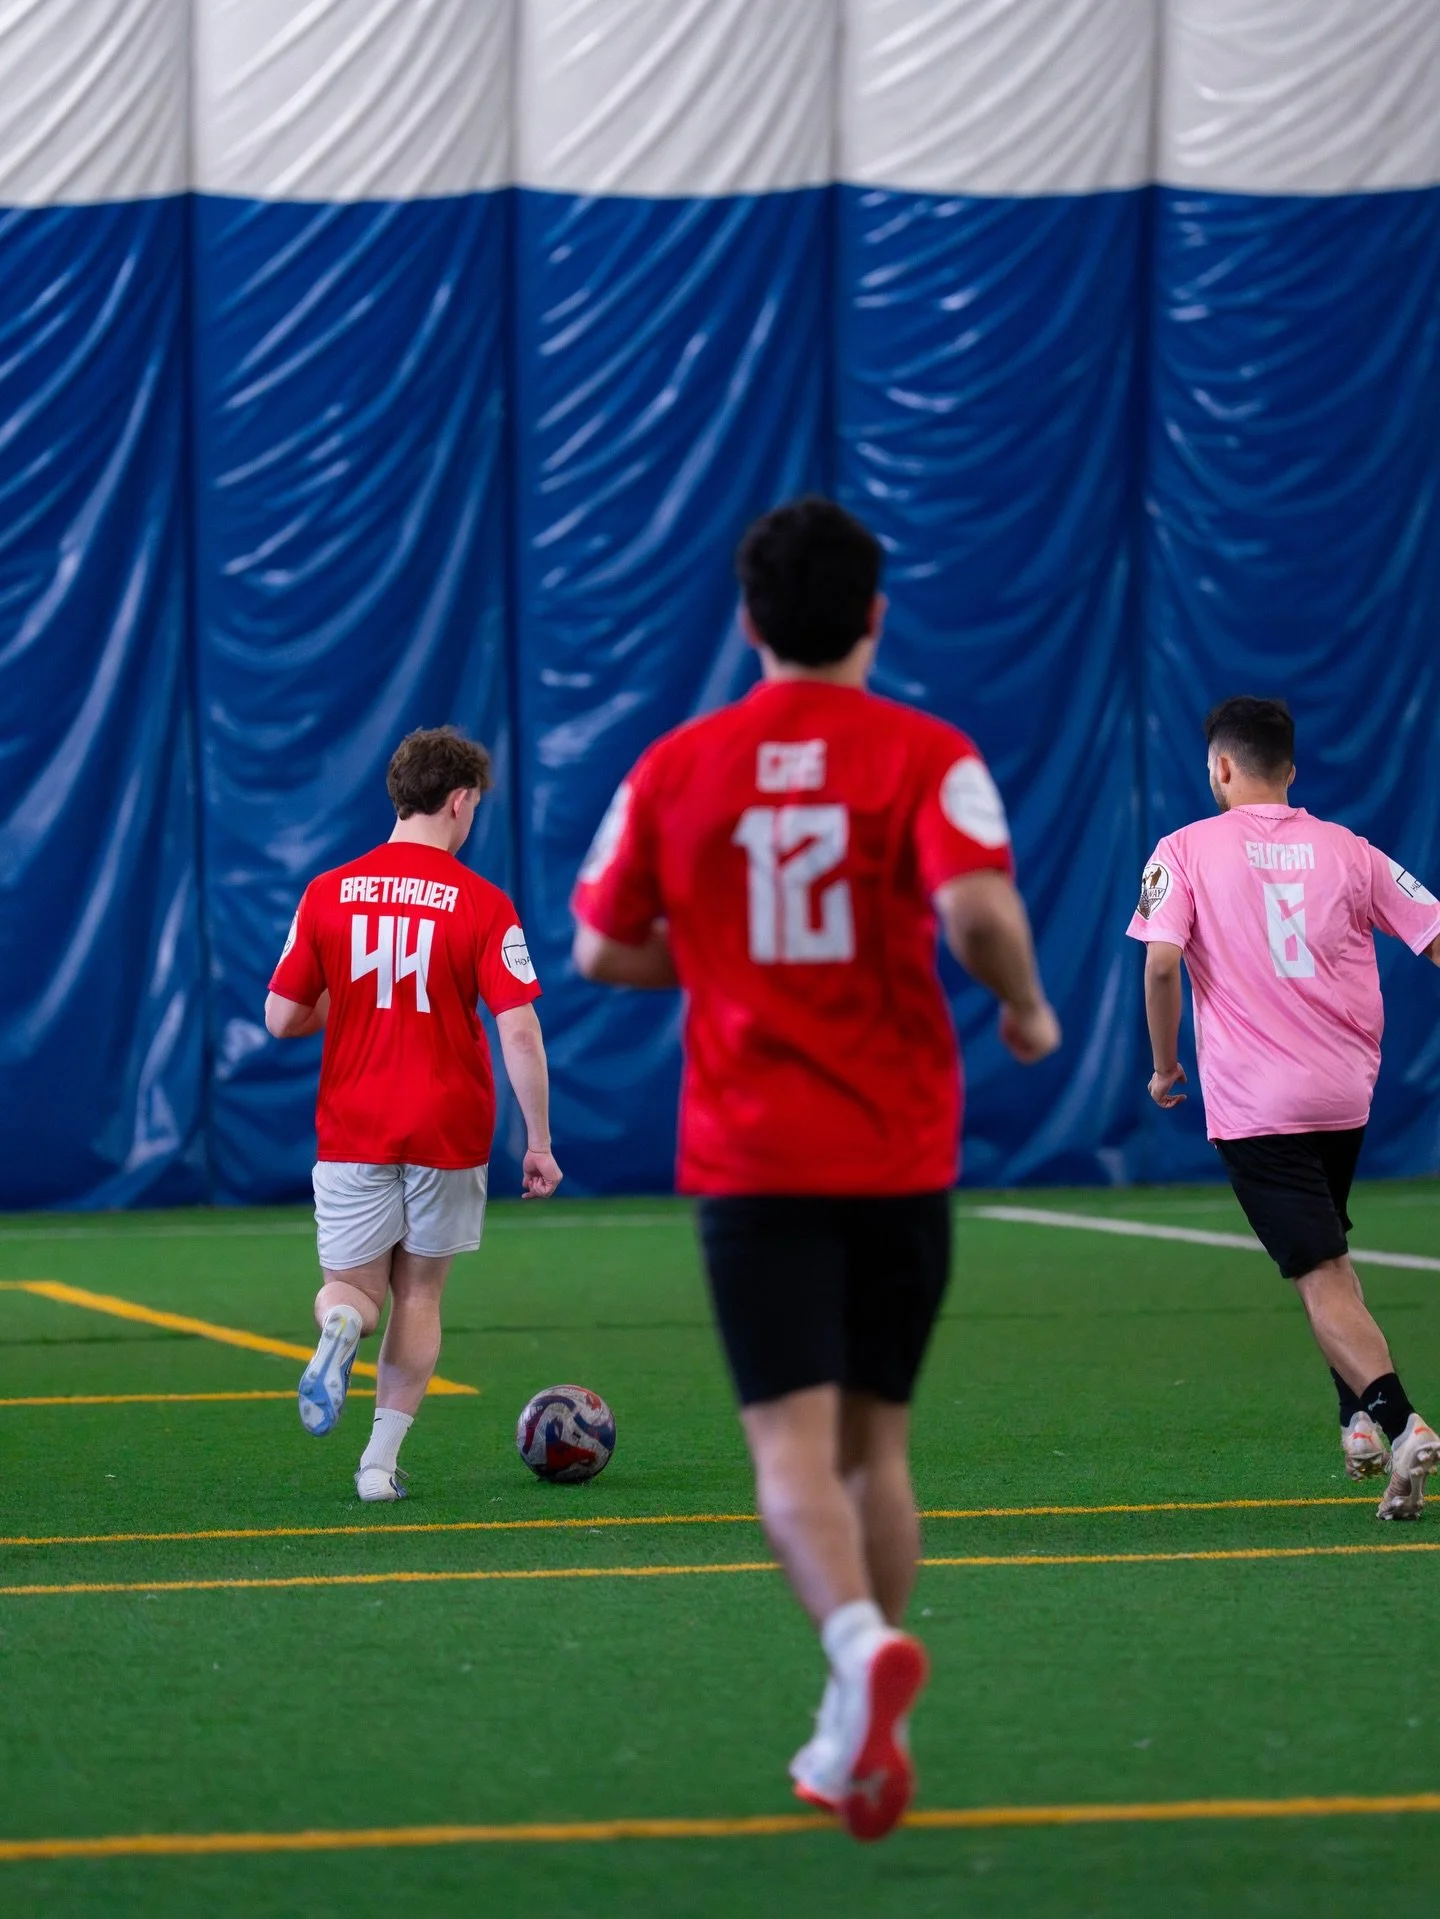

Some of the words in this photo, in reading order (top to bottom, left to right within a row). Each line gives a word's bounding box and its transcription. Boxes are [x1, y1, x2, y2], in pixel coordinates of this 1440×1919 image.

[339, 876, 459, 912] BRETHAUER
[732, 803, 855, 963] 12
[1263, 882, 1315, 979] 6
[351, 914, 435, 1013] 44
